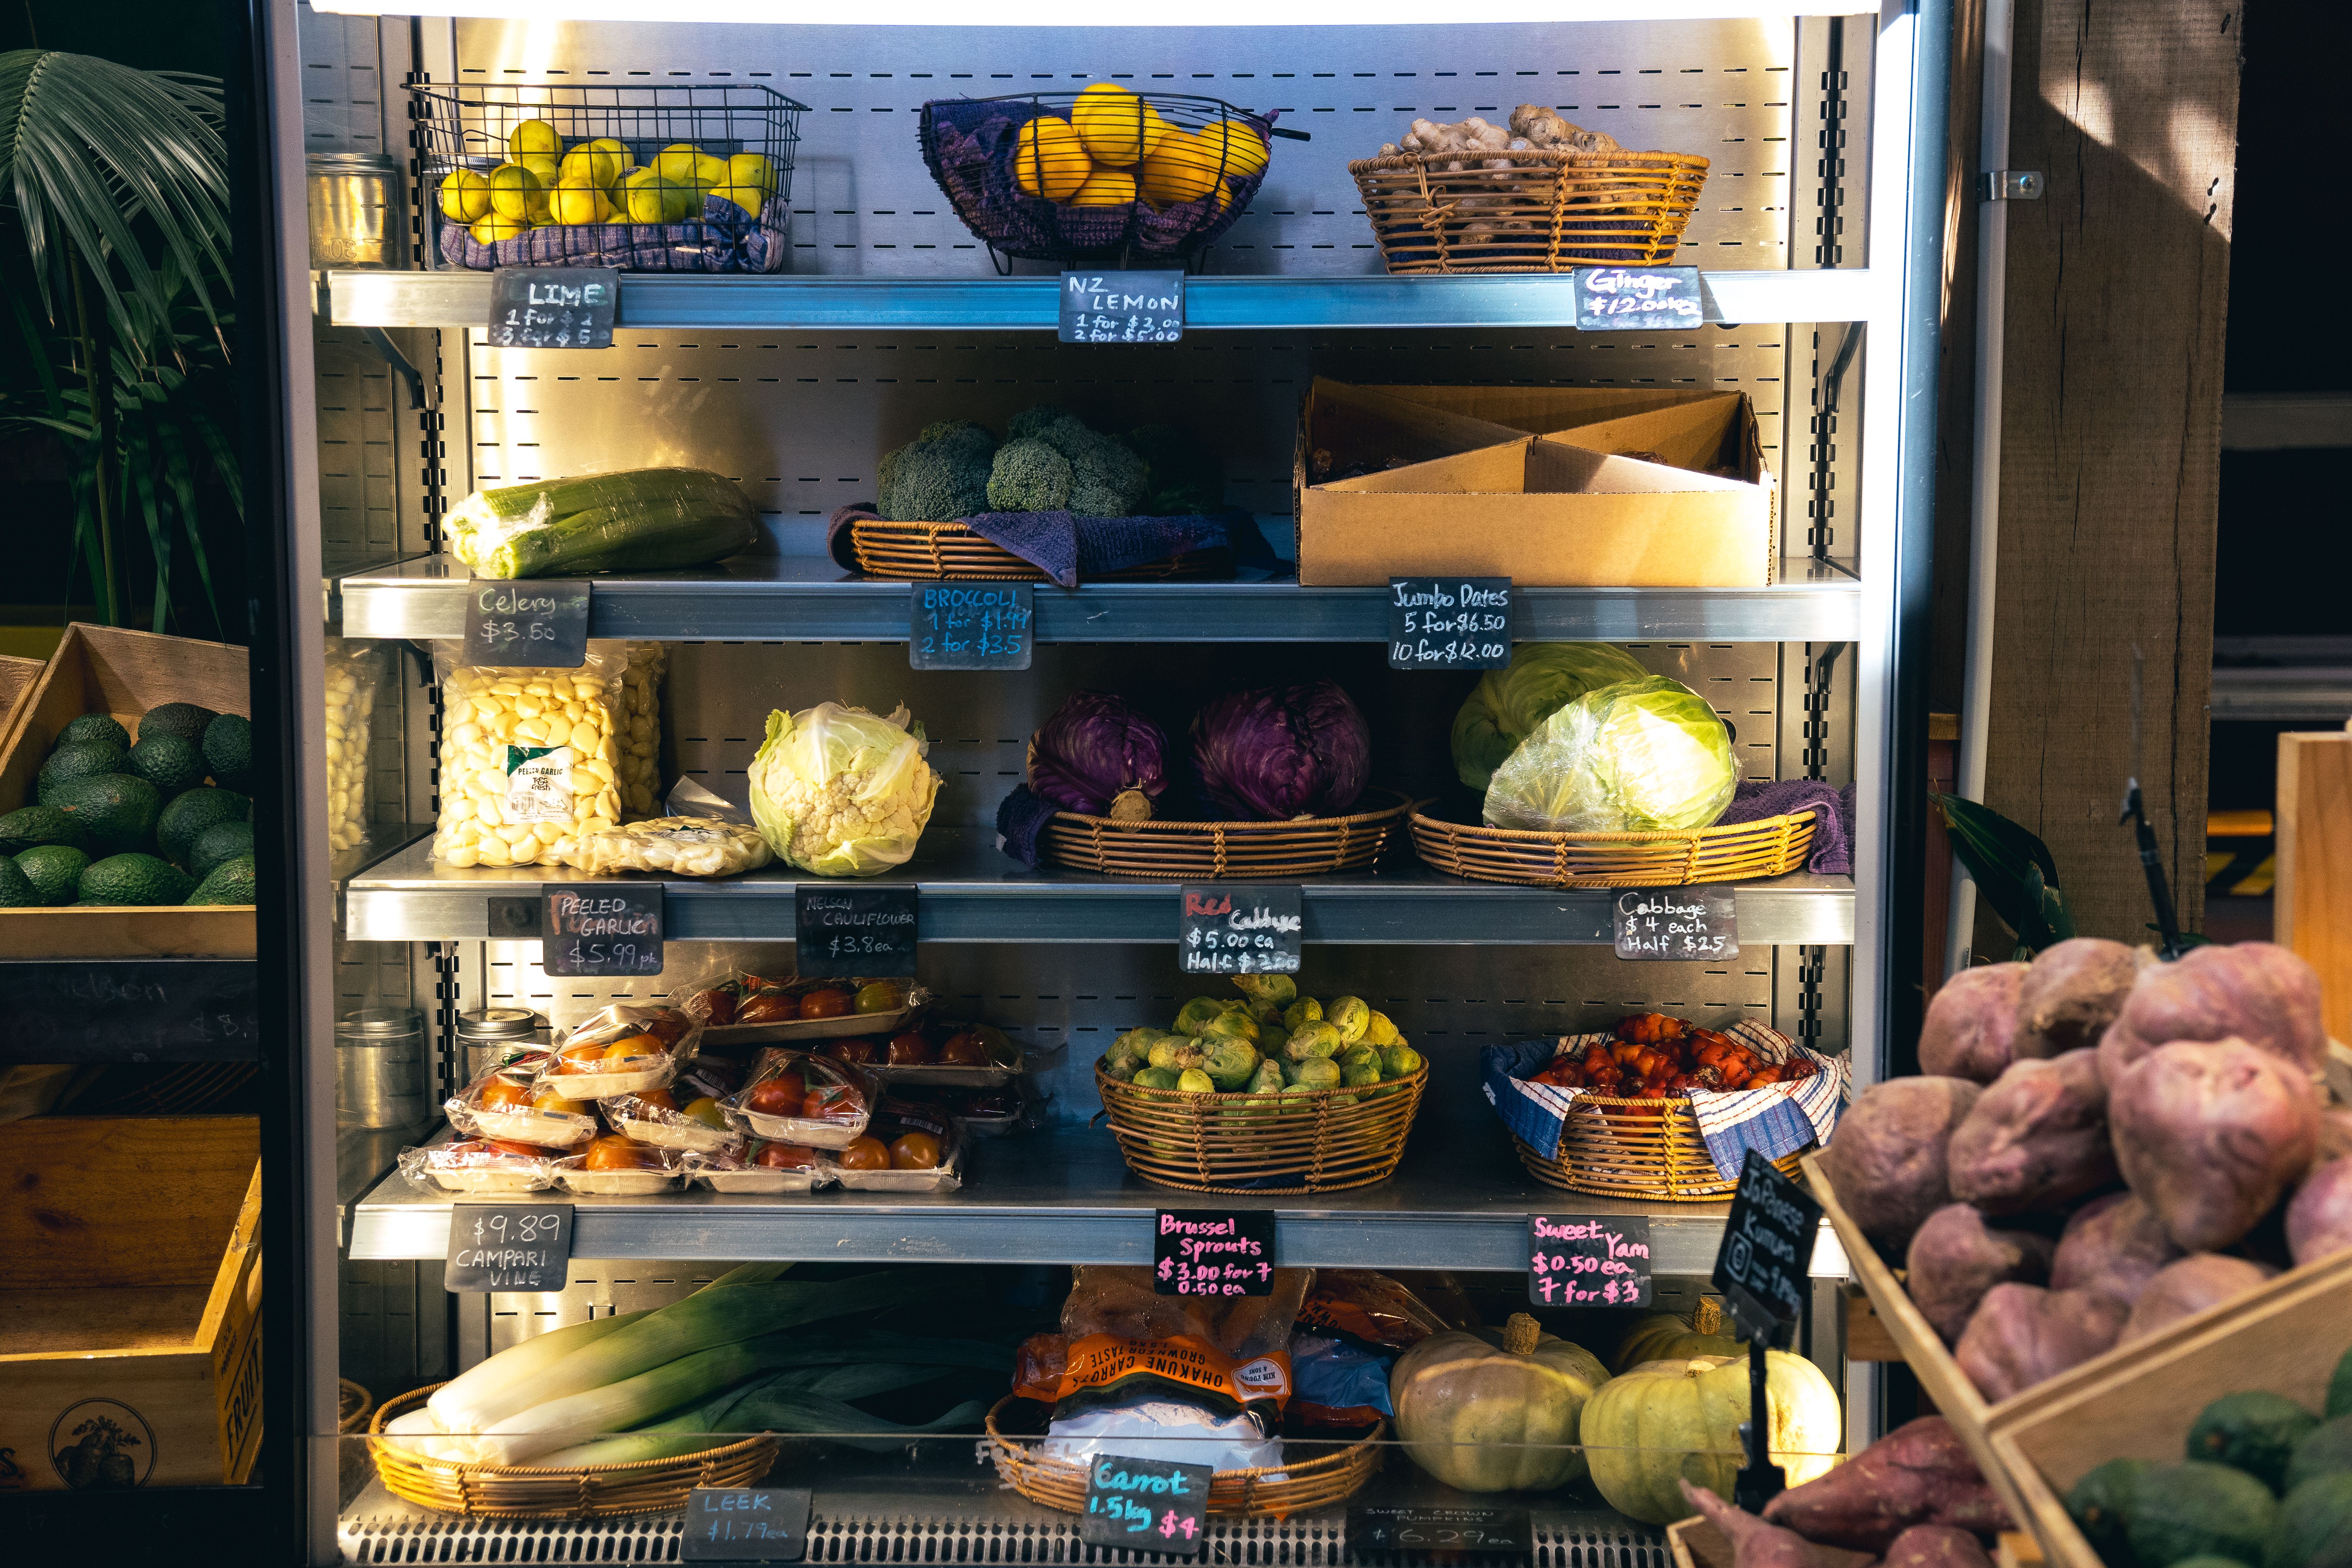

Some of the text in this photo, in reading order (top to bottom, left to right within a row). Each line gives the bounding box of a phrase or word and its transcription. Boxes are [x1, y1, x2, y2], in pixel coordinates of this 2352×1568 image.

[1069, 277, 1110, 293] NZ
[1585, 268, 1682, 299] Ginger
[529, 283, 602, 307] LIME
[1093, 294, 1179, 310] LEMON
[506, 309, 520, 325] 1
[1076, 314, 1088, 327] 1
[1093, 315, 1119, 329] for
[1075, 328, 1179, 342] 2 for $5.00
[479, 588, 555, 616] Celery
[925, 589, 1016, 609] BROCCOLI
[1393, 582, 1508, 609] Jumbo Dates
[945, 613, 971, 629] for
[981, 611, 1027, 631] $1.99
[1405, 611, 1505, 633] 5 for $6.50
[921, 637, 935, 653] 2
[942, 632, 970, 652] for
[1393, 639, 1504, 663] 10 for $12.00
[561, 898, 626, 916] PEELED
[1186, 893, 1231, 917] Red
[1619, 892, 1707, 919] Cabbage
[581, 918, 646, 937] GARLIC
[824, 912, 915, 926] CAULIFLOWER
[1669, 918, 1707, 934] each
[1187, 928, 1274, 949] $5.00 ea
[1627, 934, 1670, 951] Half
[570, 939, 635, 967] $5.99
[1187, 951, 1232, 971] Half
[474, 1214, 560, 1245] $9.89
[1160, 1214, 1234, 1236] Brussel
[1534, 1217, 1649, 1260] Sweet Yam
[456, 1249, 545, 1270] CAMPARI
[1180, 1237, 1261, 1263] Sprouts
[1157, 1256, 1272, 1282] $3.00 for 7
[1532, 1252, 1634, 1275] $0.50 ea
[1178, 1280, 1246, 1296] 0.50 ea
[1538, 1277, 1639, 1304] 7 for $3
[1090, 1346, 1124, 1368] TASTE
[1158, 1349, 1205, 1365] GROWN
[1073, 1356, 1223, 1388] OHAKUNE CARROTS
[1262, 1372, 1276, 1381] KIM
[226, 1339, 259, 1461] FRUIT
[1095, 1462, 1190, 1495] Carrot
[704, 1494, 771, 1512] LEEK
[1159, 1510, 1200, 1540] $4
